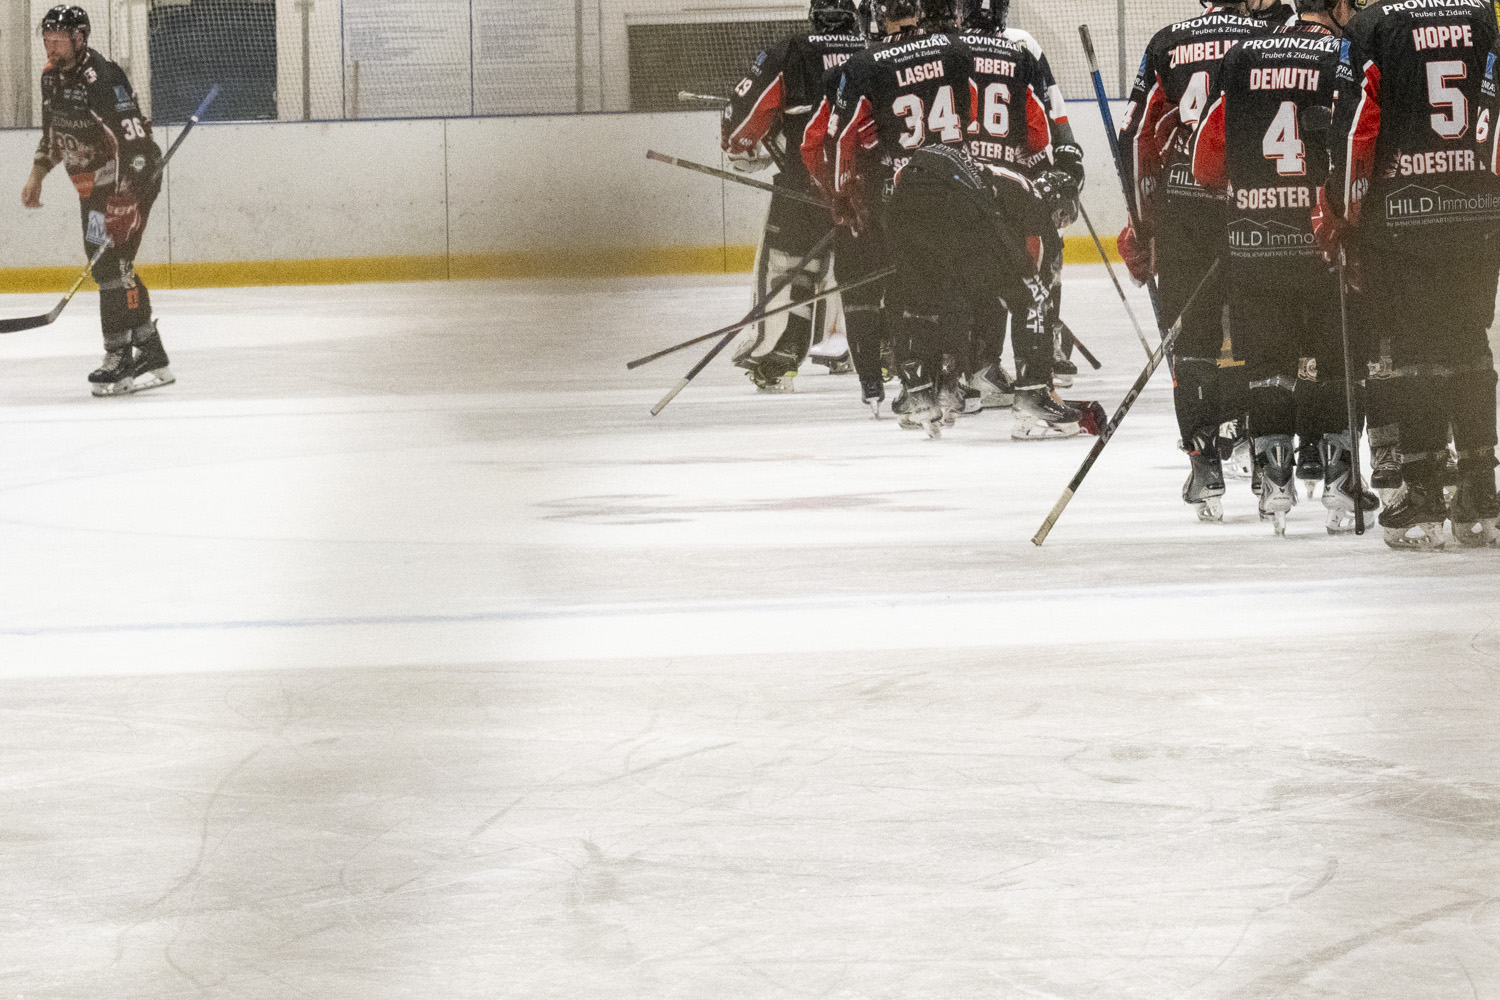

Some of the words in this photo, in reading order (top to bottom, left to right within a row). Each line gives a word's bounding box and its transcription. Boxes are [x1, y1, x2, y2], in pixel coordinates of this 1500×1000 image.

[1171, 15, 1263, 32] PROVINZIAL
[1409, 10, 1436, 18] Teuber
[1191, 28, 1216, 36] Teuber
[1412, 25, 1473, 51] HOPPE
[873, 34, 950, 61] PROVINZIAL
[1243, 36, 1336, 53] PROVINZIAL
[1294, 52, 1319, 60] Zidaric
[895, 60, 945, 87] LASCH
[1250, 67, 1320, 92] DEMUTH
[1426, 60, 1468, 139] 5
[121, 117, 146, 140] 36
[892, 85, 963, 150] 34
[1262, 101, 1307, 176] 4
[1400, 150, 1475, 176] SOESTER
[1237, 187, 1310, 209] SOESTER
[1389, 197, 1433, 215] HILD
